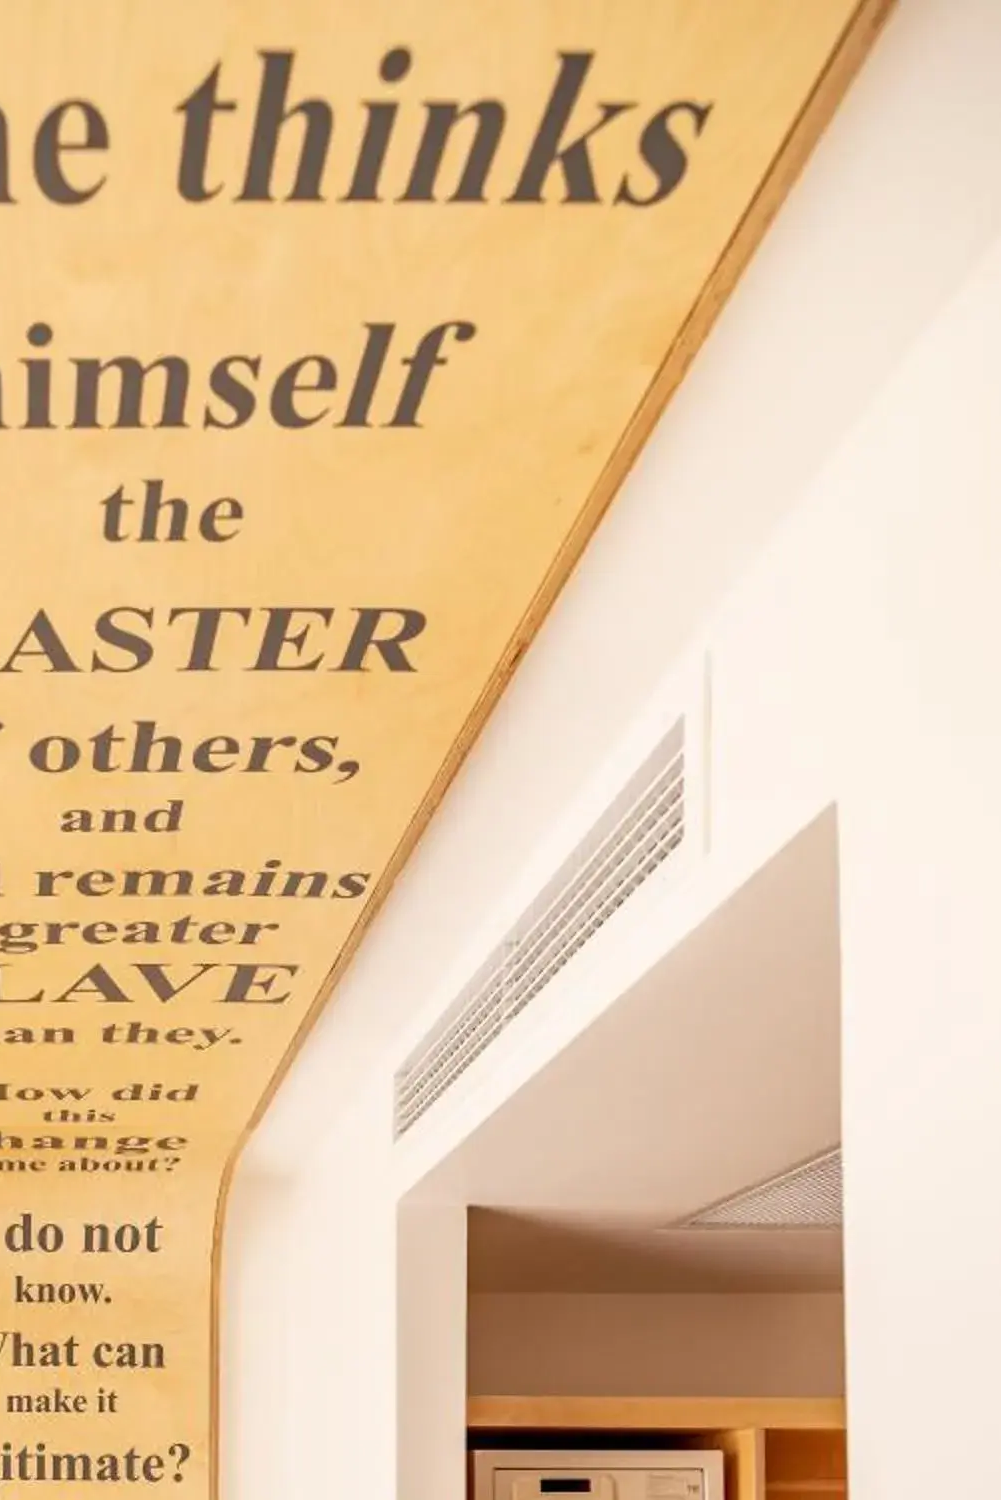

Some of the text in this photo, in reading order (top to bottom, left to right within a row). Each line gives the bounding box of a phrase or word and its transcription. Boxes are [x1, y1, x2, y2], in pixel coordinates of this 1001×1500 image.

[176, 46, 713, 208] thinks
[101, 479, 244, 543] the
[28, 720, 360, 783] others,
[60, 799, 184, 833] and
[35, 859, 371, 899] remains
[102, 1021, 242, 1051] they.
[112, 1083, 199, 1102] did
[43, 1109, 115, 1123] this
[58, 1157, 181, 1172] about?
[4, 1213, 64, 1253] do
[82, 1216, 164, 1253] not
[14, 1275, 112, 1305] know.
[92, 1343, 165, 1369] can
[6, 1387, 118, 1414] make it
